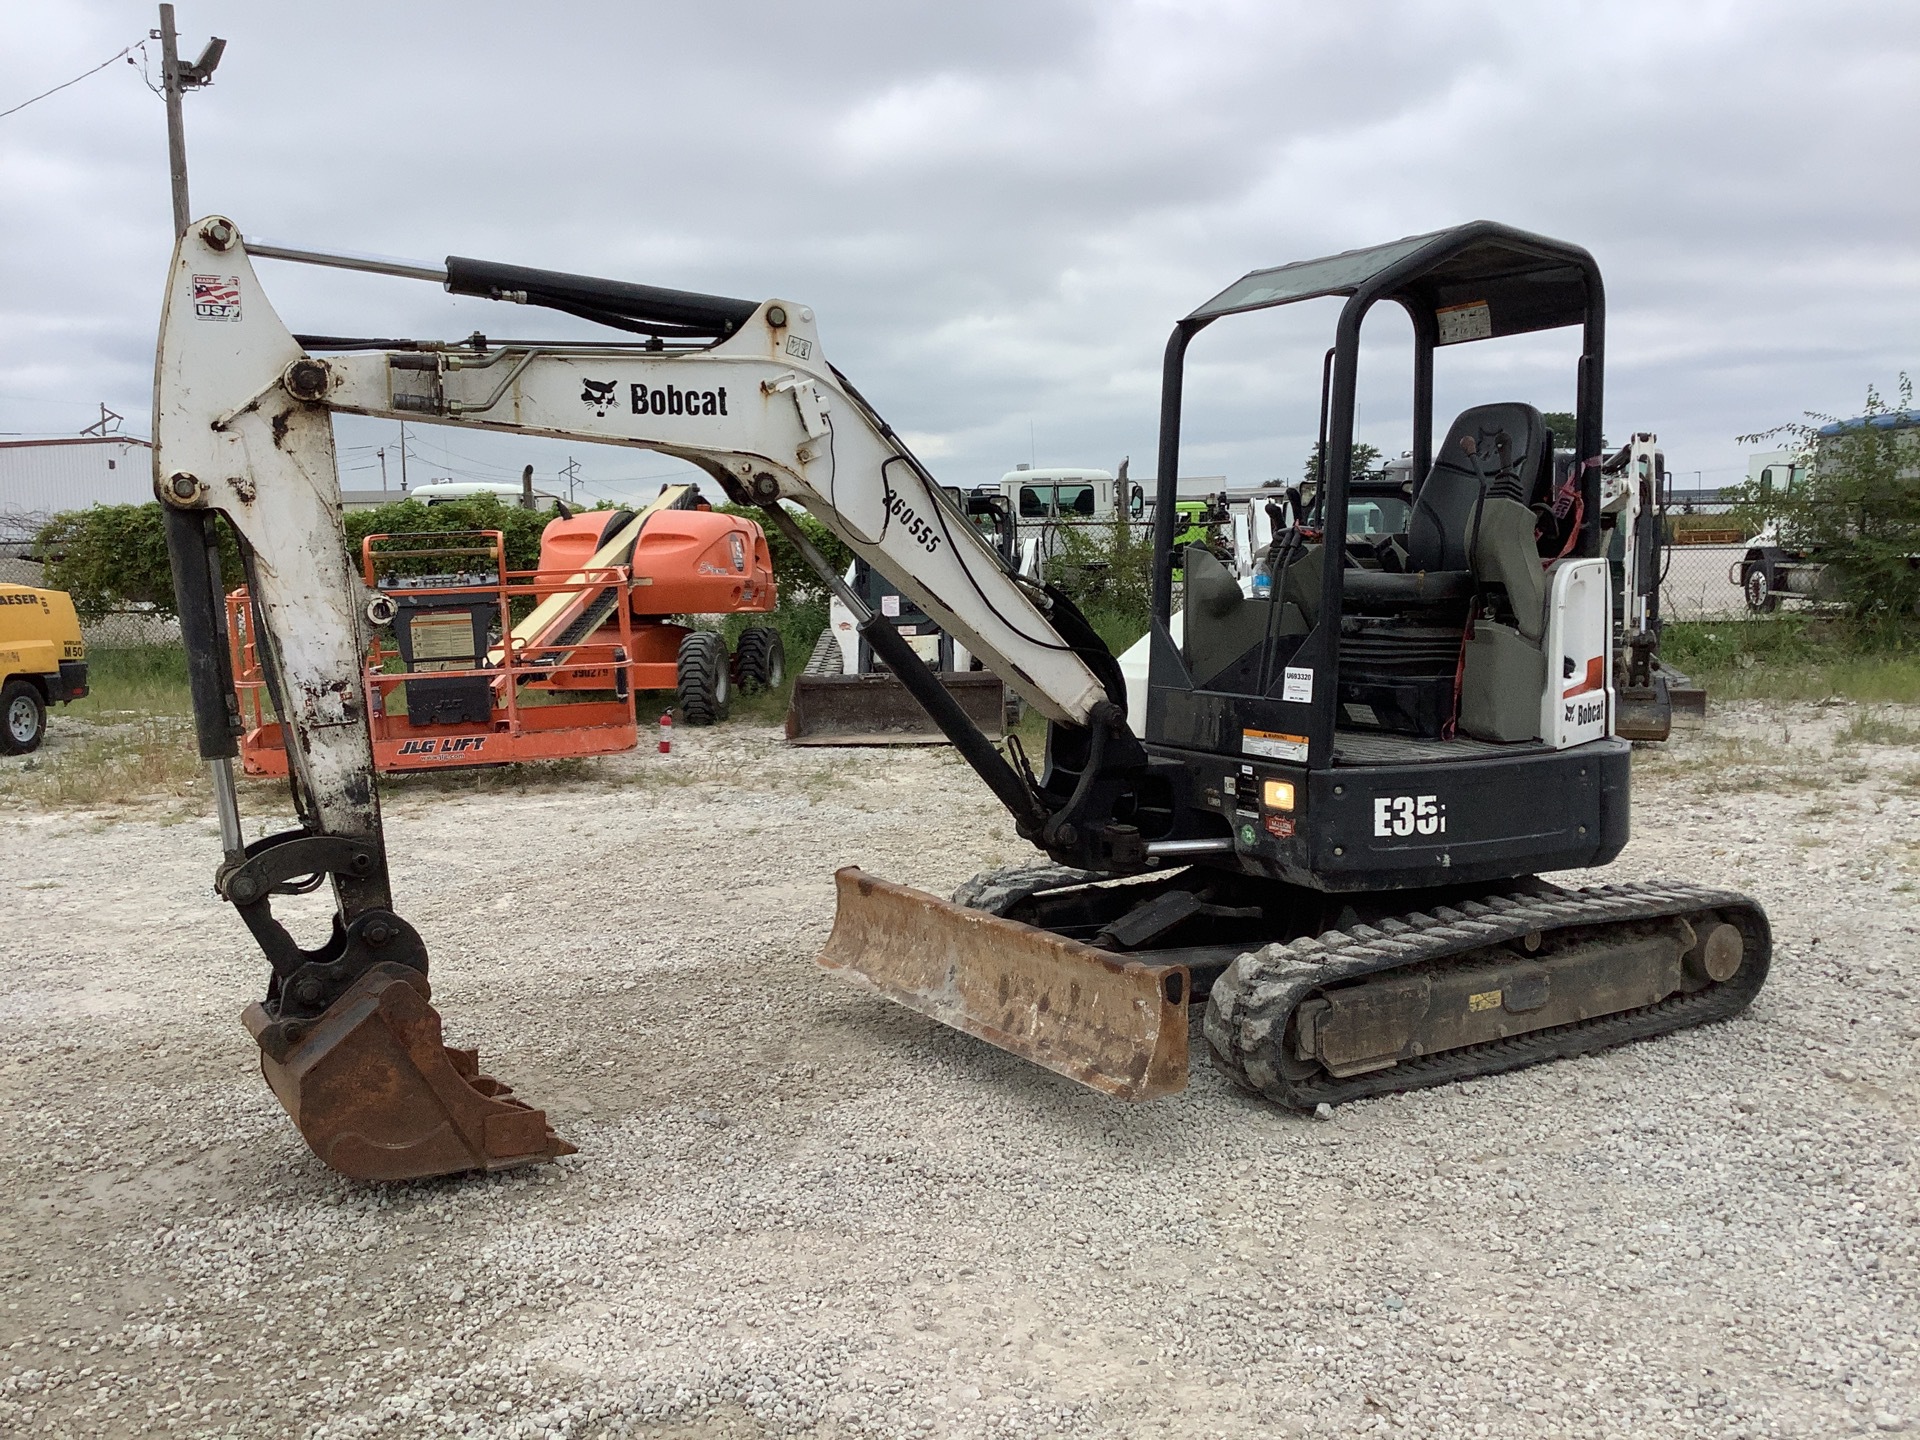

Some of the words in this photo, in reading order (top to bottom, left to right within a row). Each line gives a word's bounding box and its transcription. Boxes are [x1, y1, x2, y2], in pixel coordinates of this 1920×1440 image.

[197, 305, 237, 316] USA
[630, 383, 728, 416] Bobcat
[882, 489, 942, 553] 360555
[0, 594, 39, 605] AESER
[64, 647, 72, 657] M
[73, 647, 83, 657] 50
[1286, 673, 1312, 681] U693320
[1577, 700, 1604, 726] Bobcat
[398, 740, 436, 755] JLG
[440, 737, 487, 753] LIFT
